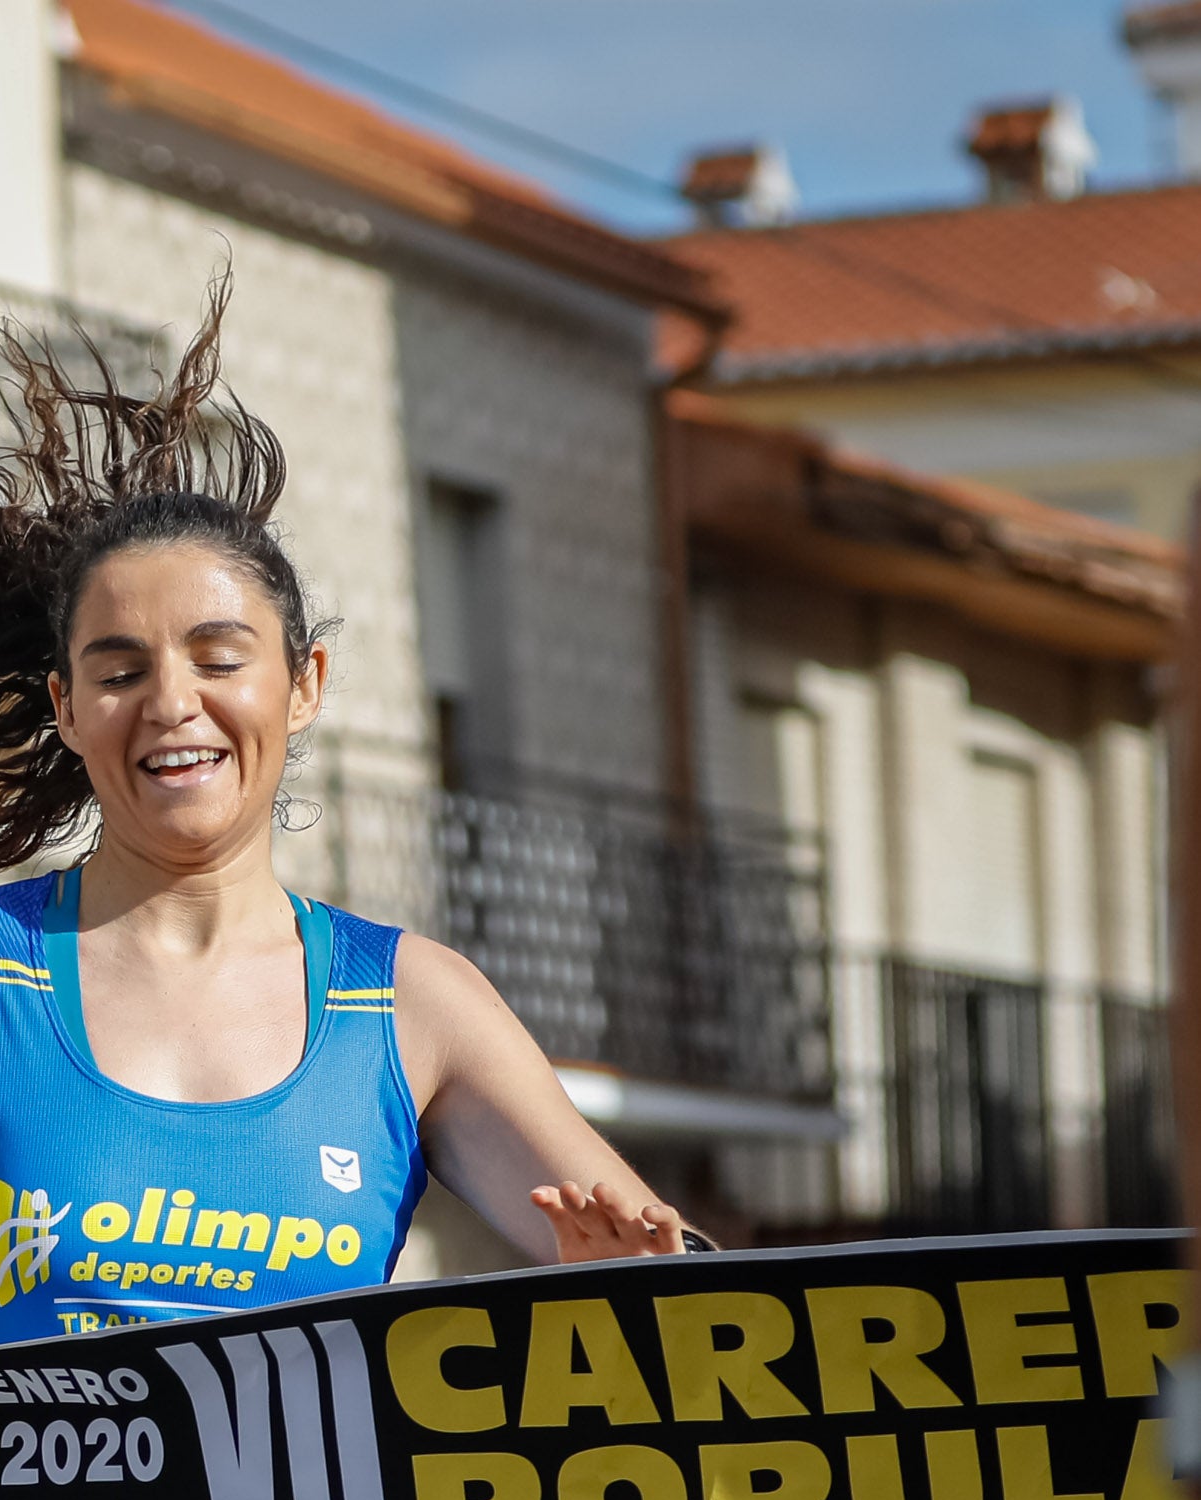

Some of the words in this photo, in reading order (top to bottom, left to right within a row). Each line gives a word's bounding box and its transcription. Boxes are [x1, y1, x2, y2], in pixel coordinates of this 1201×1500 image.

[82, 1188, 361, 1271] olimpo
[70, 1252, 256, 1291] deportes
[0, 1416, 164, 1485] 2020
